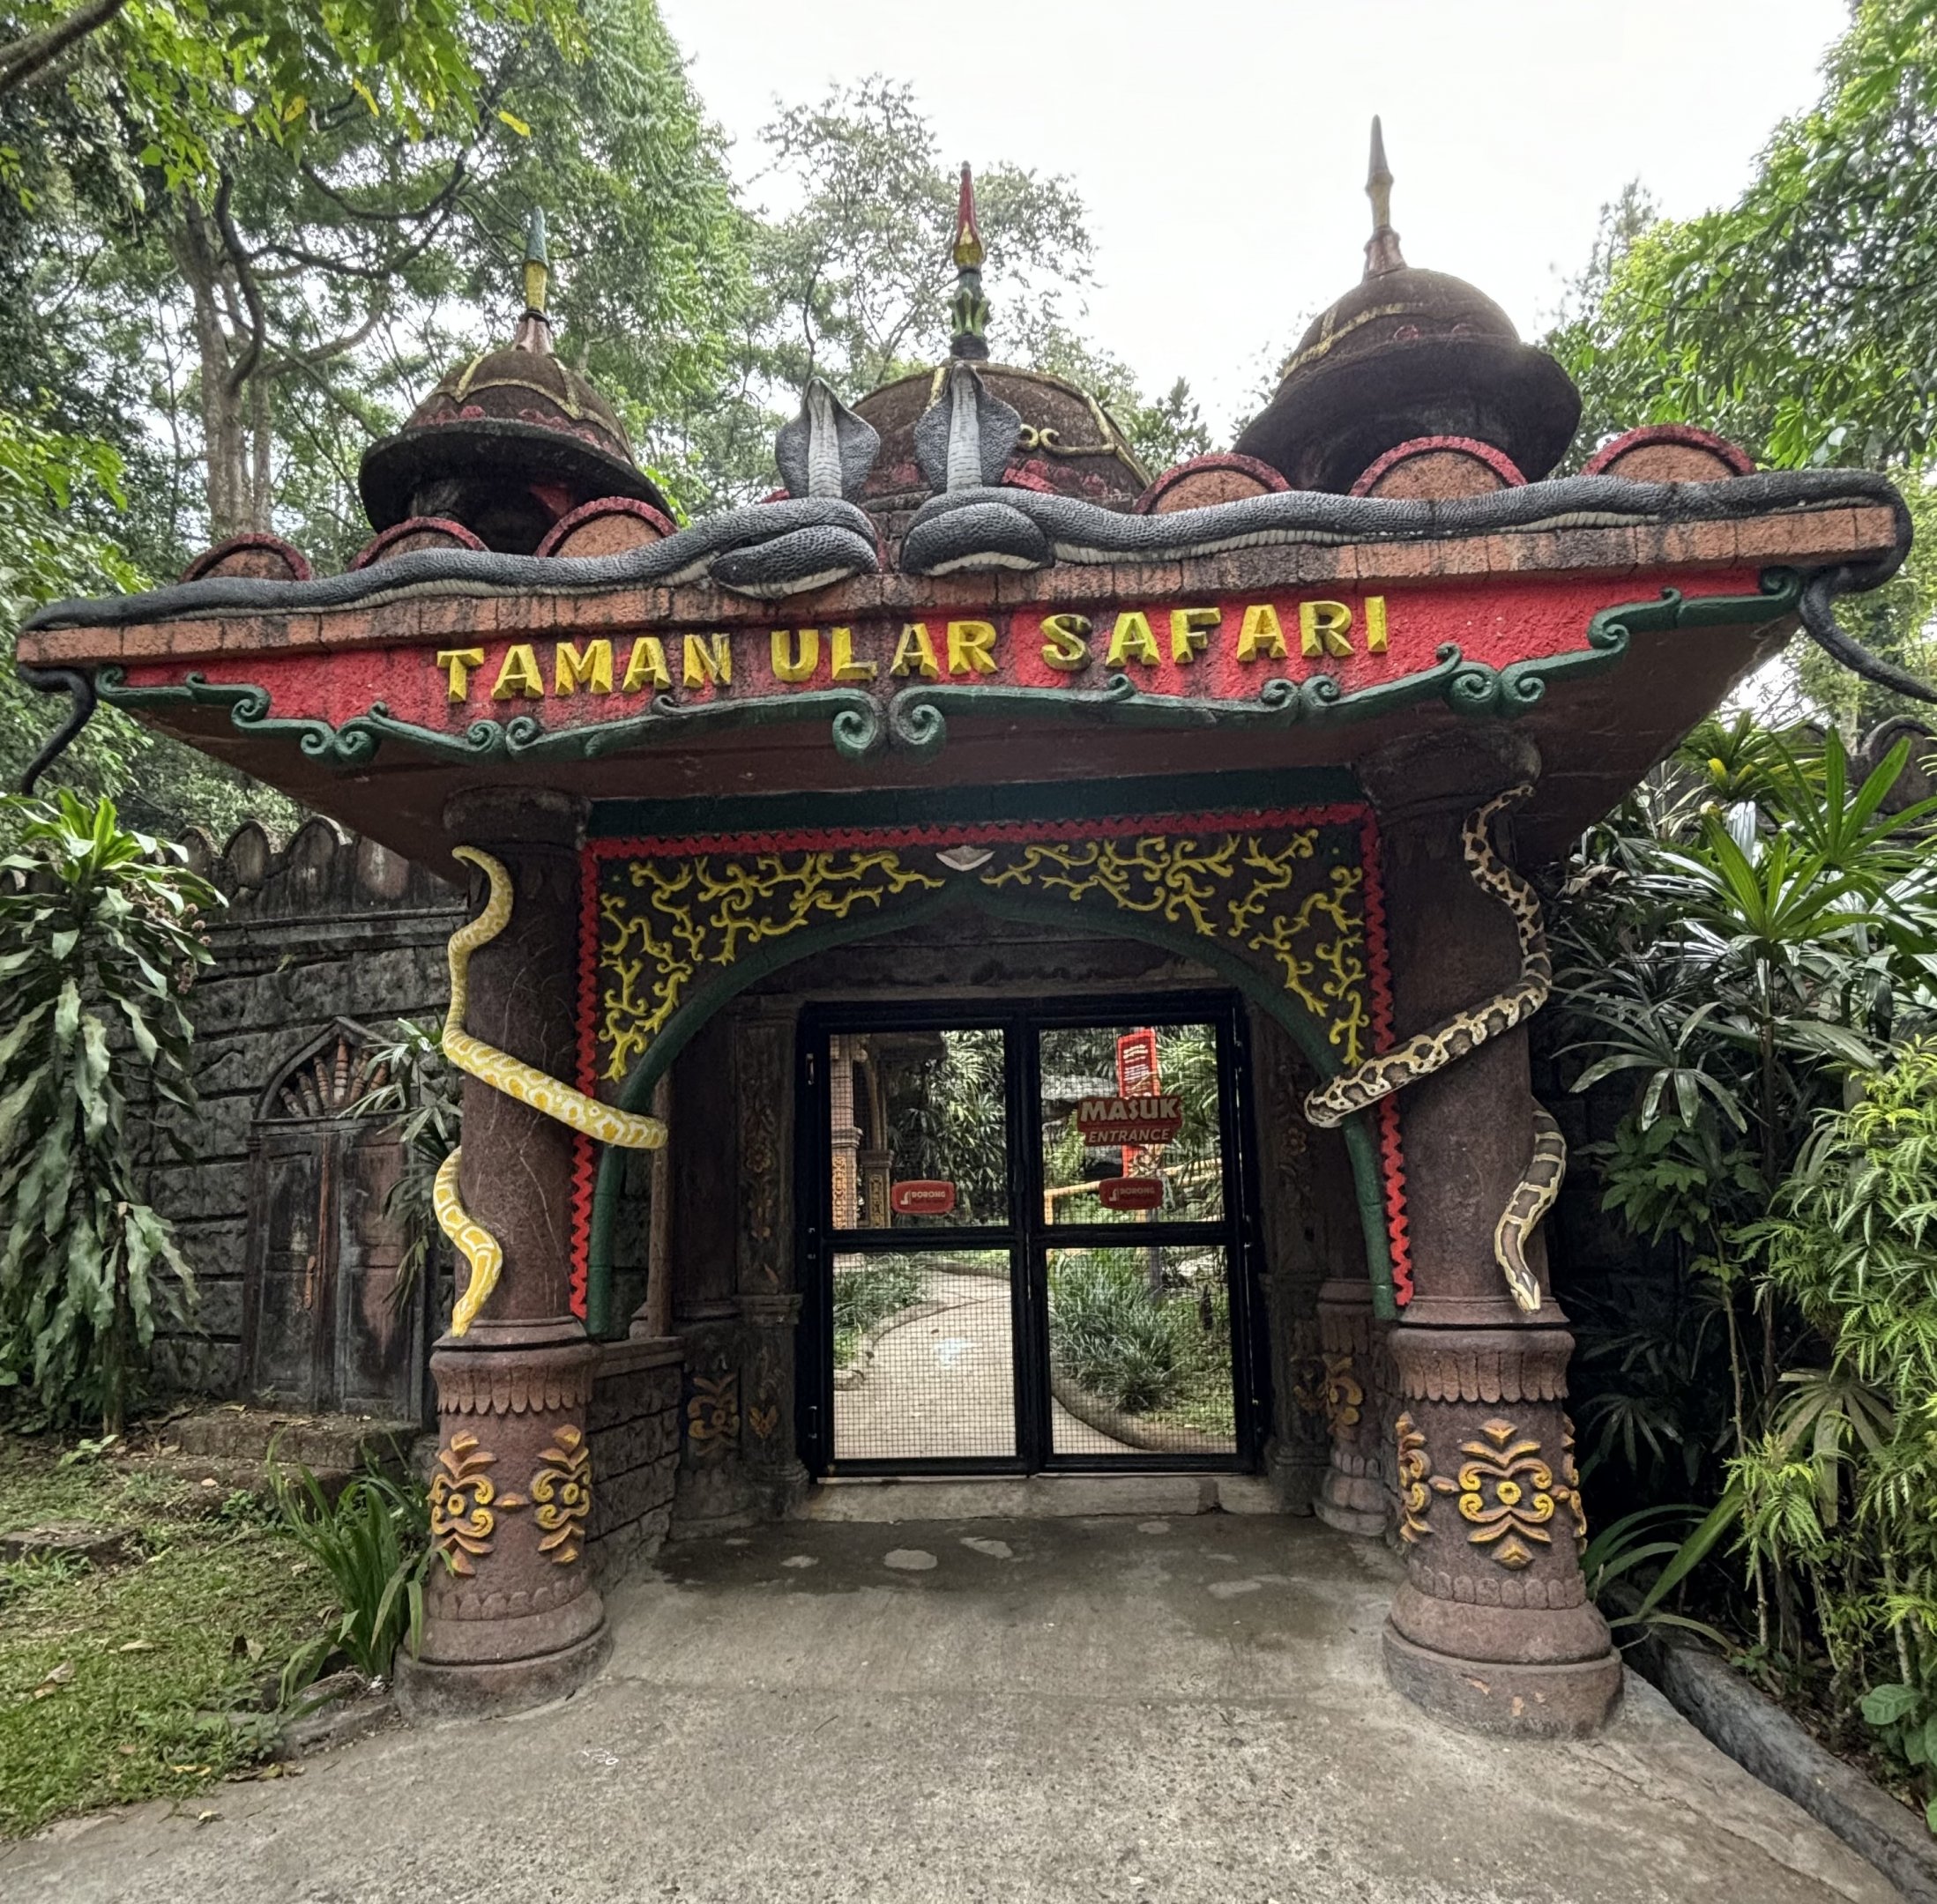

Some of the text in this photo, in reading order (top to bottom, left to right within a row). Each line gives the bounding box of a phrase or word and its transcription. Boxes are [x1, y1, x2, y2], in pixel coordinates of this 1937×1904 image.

[436, 595, 1389, 703] TAMAN ULAR SAFARI
[1081, 1099, 1178, 1122] MASUK
[1089, 1129, 1169, 1143] ENTRANCE
